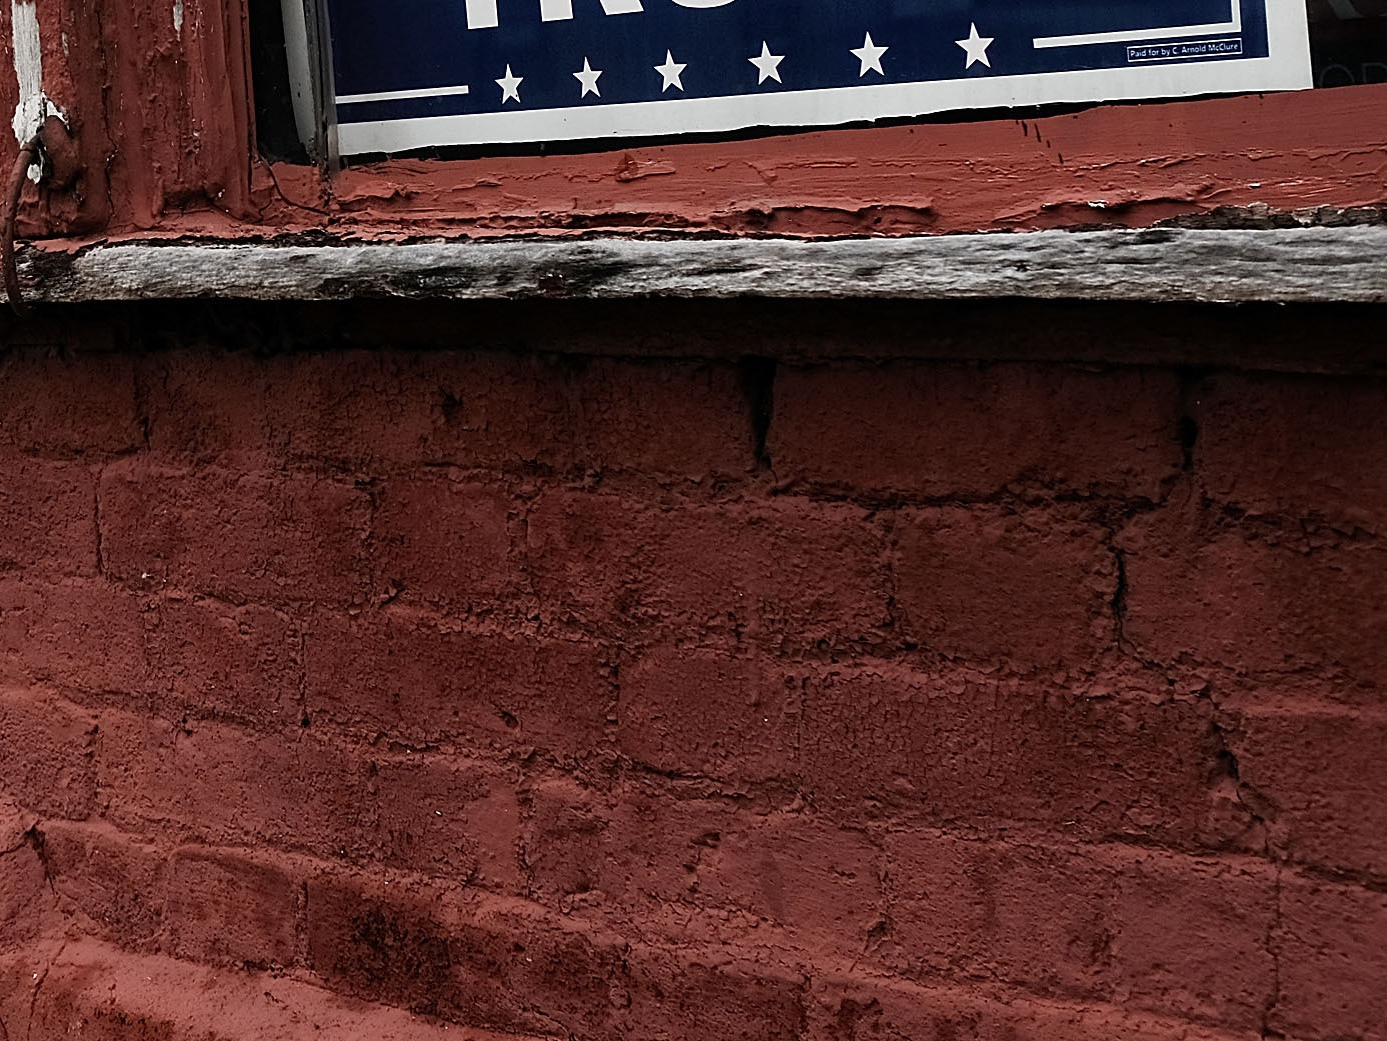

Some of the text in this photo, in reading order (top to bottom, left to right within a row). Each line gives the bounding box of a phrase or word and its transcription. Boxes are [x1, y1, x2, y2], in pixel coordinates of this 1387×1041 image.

[1130, 49, 1147, 57] Paid
[1148, 48, 1160, 57] for
[1161, 48, 1171, 57] by
[1181, 45, 1207, 54] Arnold
[1208, 42, 1238, 52] McClure
